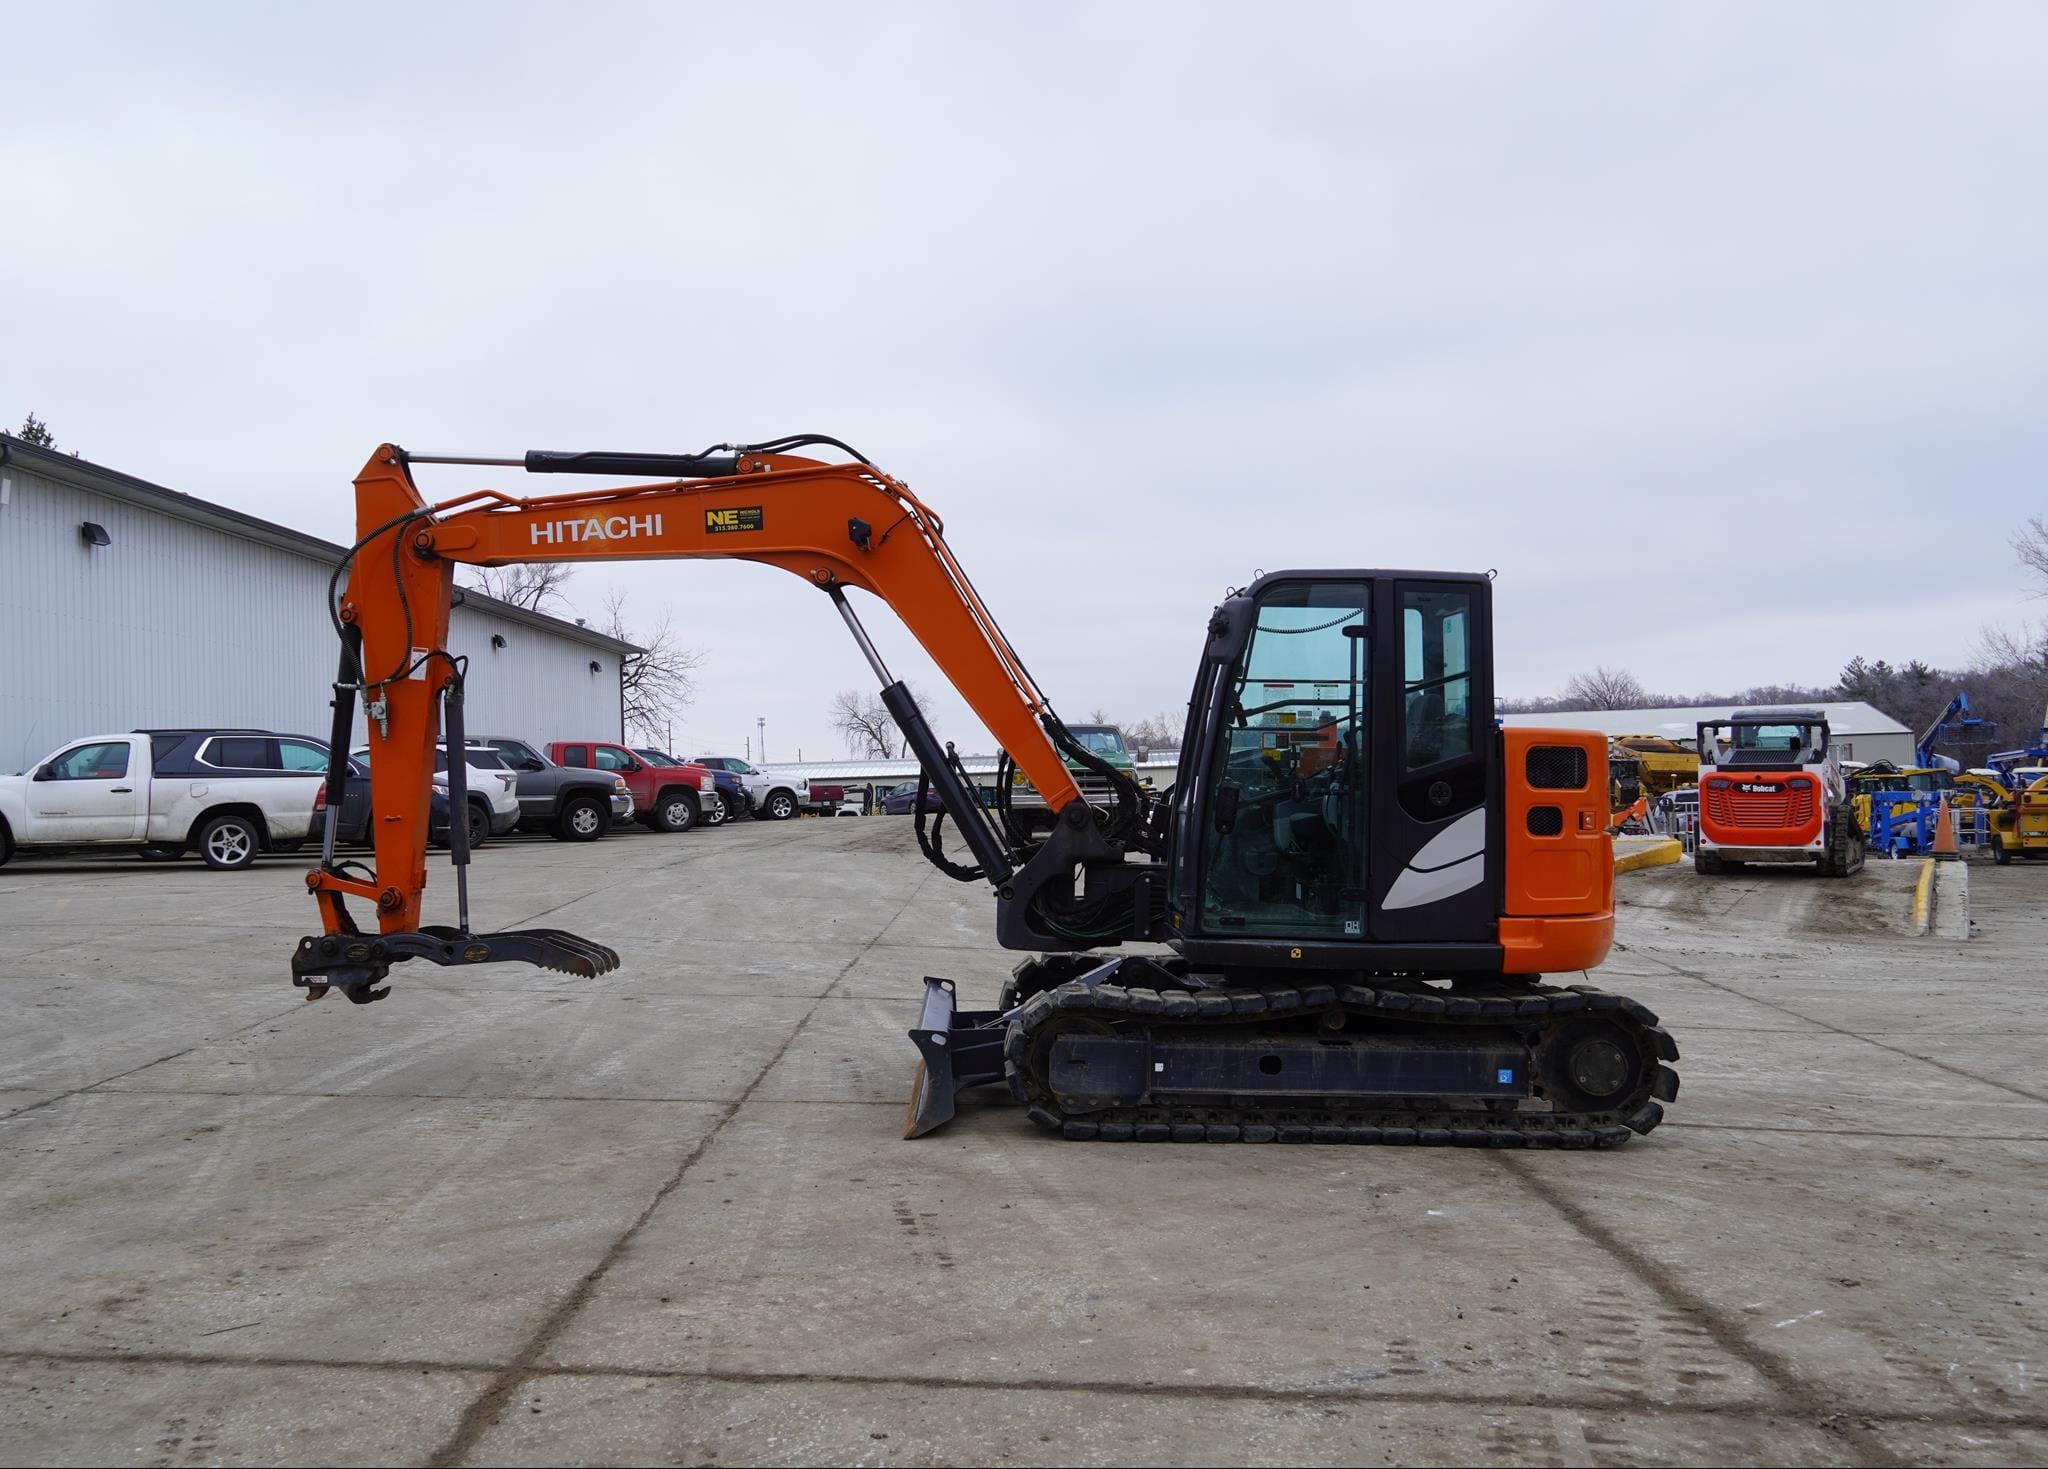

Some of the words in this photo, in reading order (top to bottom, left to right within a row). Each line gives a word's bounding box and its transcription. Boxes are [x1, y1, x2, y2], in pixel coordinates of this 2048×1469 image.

[707, 510, 739, 526] NE
[530, 514, 663, 545] HITACHI
[1752, 785, 1776, 793] Bobcat
